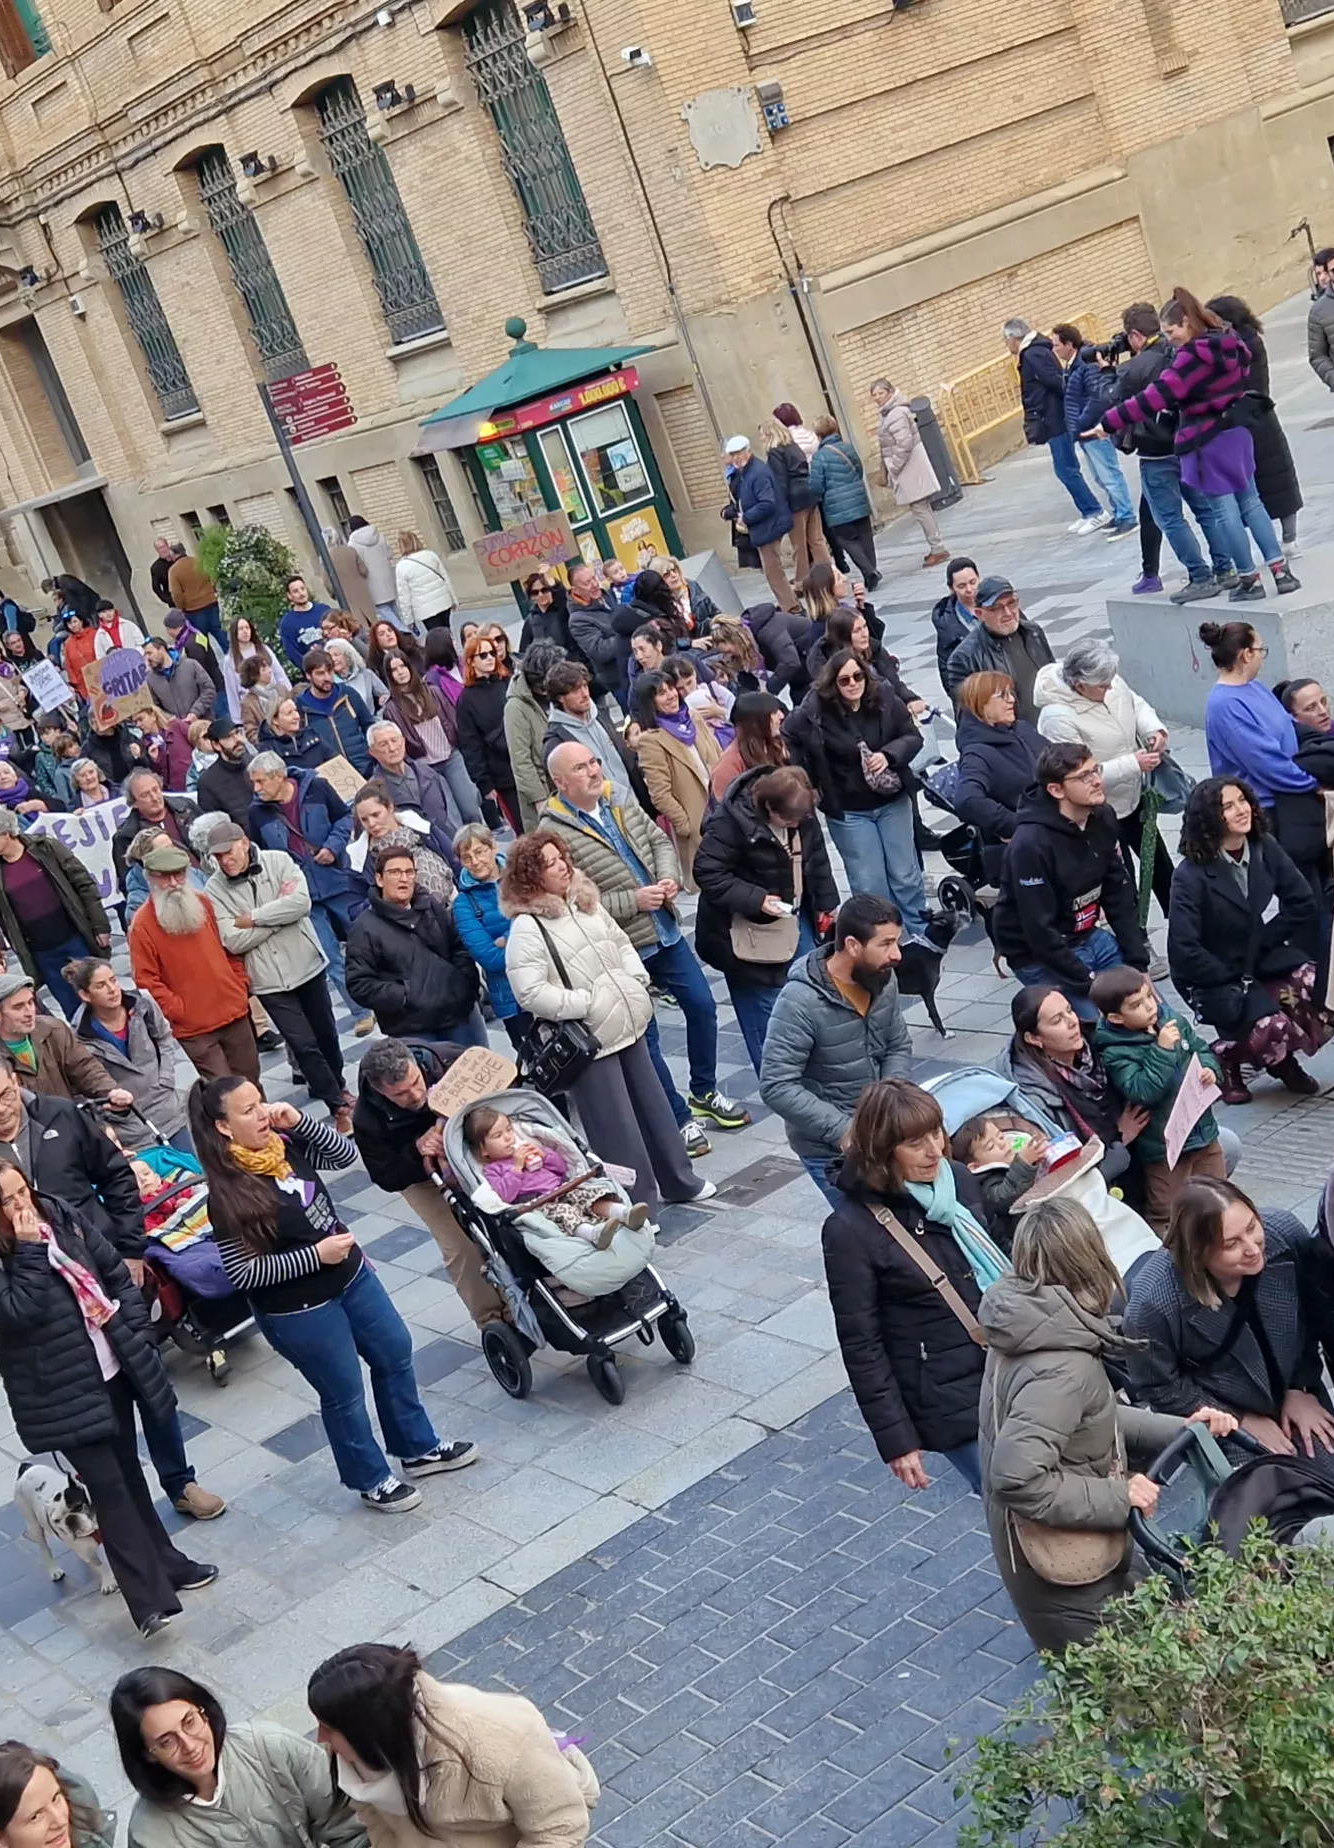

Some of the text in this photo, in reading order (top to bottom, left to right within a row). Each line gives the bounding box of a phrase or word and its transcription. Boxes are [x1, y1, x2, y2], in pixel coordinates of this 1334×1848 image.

[488, 527, 565, 567] CORAZÓN
[102, 663, 147, 697] GRITAR
[468, 1057, 503, 1094] LIBRE
